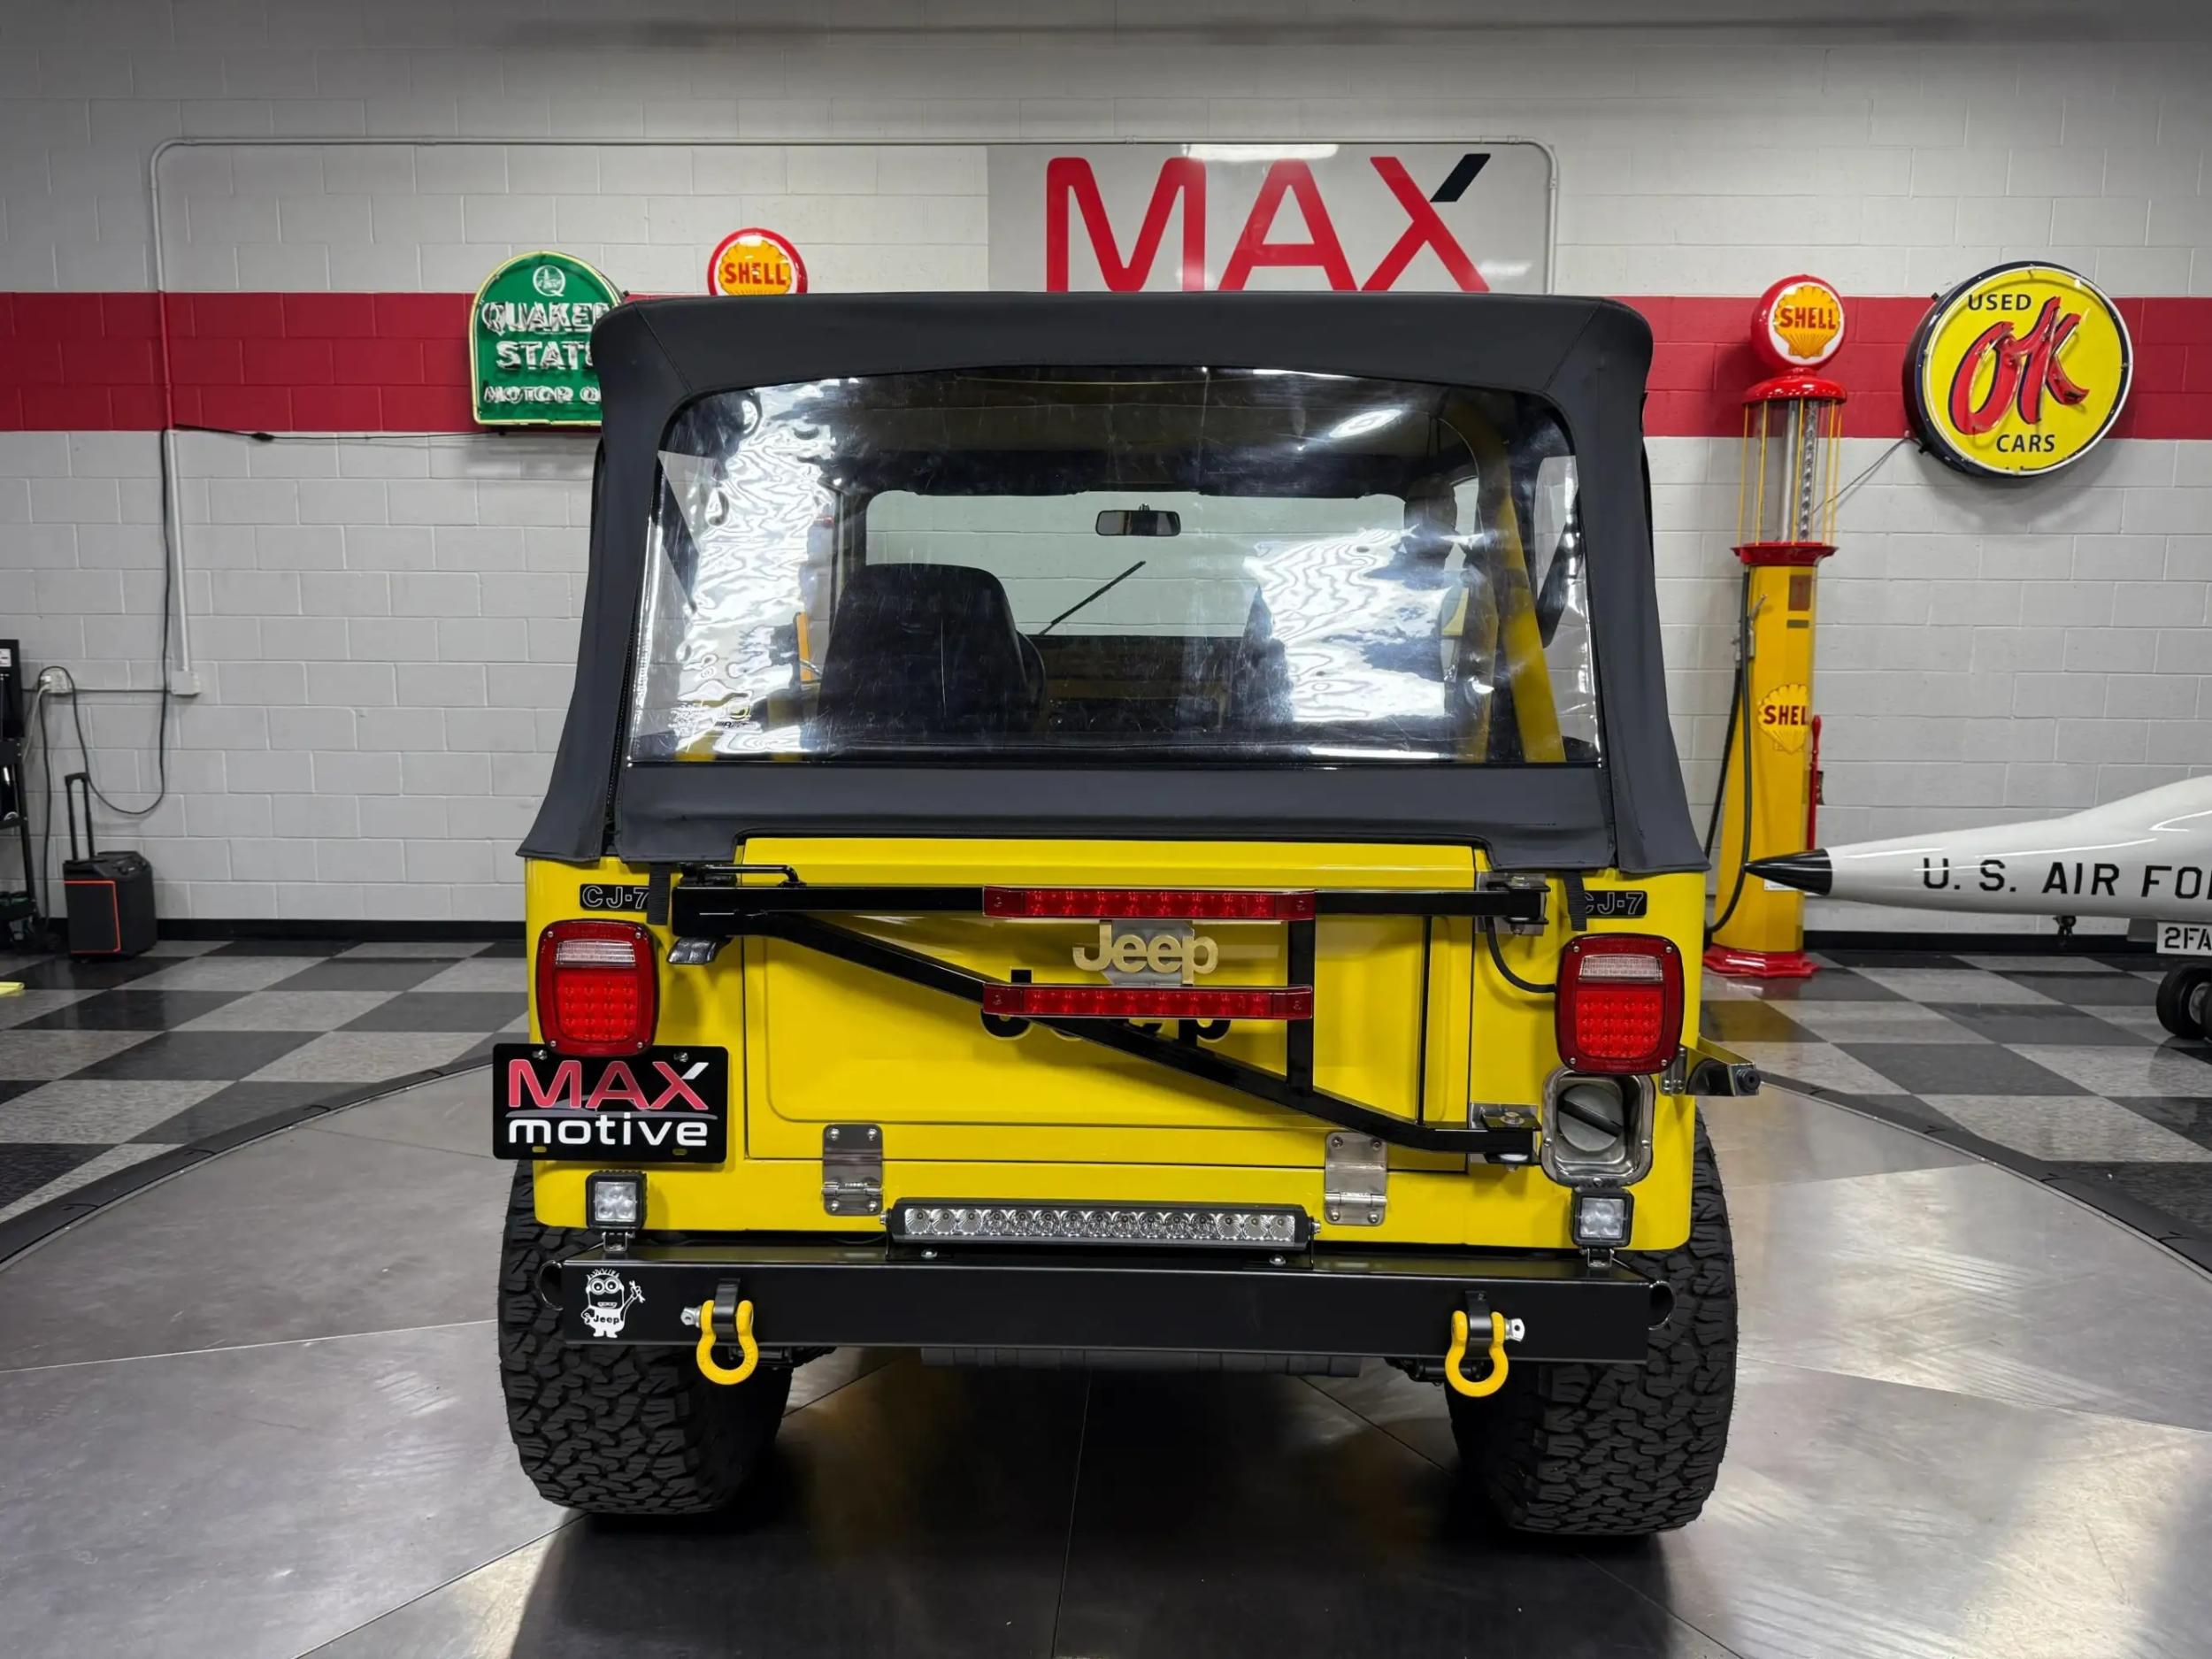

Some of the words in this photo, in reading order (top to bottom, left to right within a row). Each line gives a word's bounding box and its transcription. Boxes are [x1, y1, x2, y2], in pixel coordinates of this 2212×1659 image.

[1046, 153, 1492, 292] MAX
[724, 262, 787, 286] SHELL
[1968, 294, 2032, 311] USED
[1780, 306, 1837, 330] SHELL
[1947, 296, 2090, 435] OK
[484, 386, 573, 403] MOTOR
[1996, 434, 2055, 452] CARS
[1763, 704, 1809, 726] SHEL
[1924, 858, 1960, 890] U.
[1978, 859, 2016, 892] S.
[2042, 862, 2120, 896] AIR
[2141, 864, 2212, 900] FO
[2164, 926, 2212, 950] 2FA
[1072, 924, 1218, 984] Jeep
[509, 1059, 709, 1110] MAX
[509, 1112, 708, 1147] motive
[593, 1315, 620, 1325] Jeep
